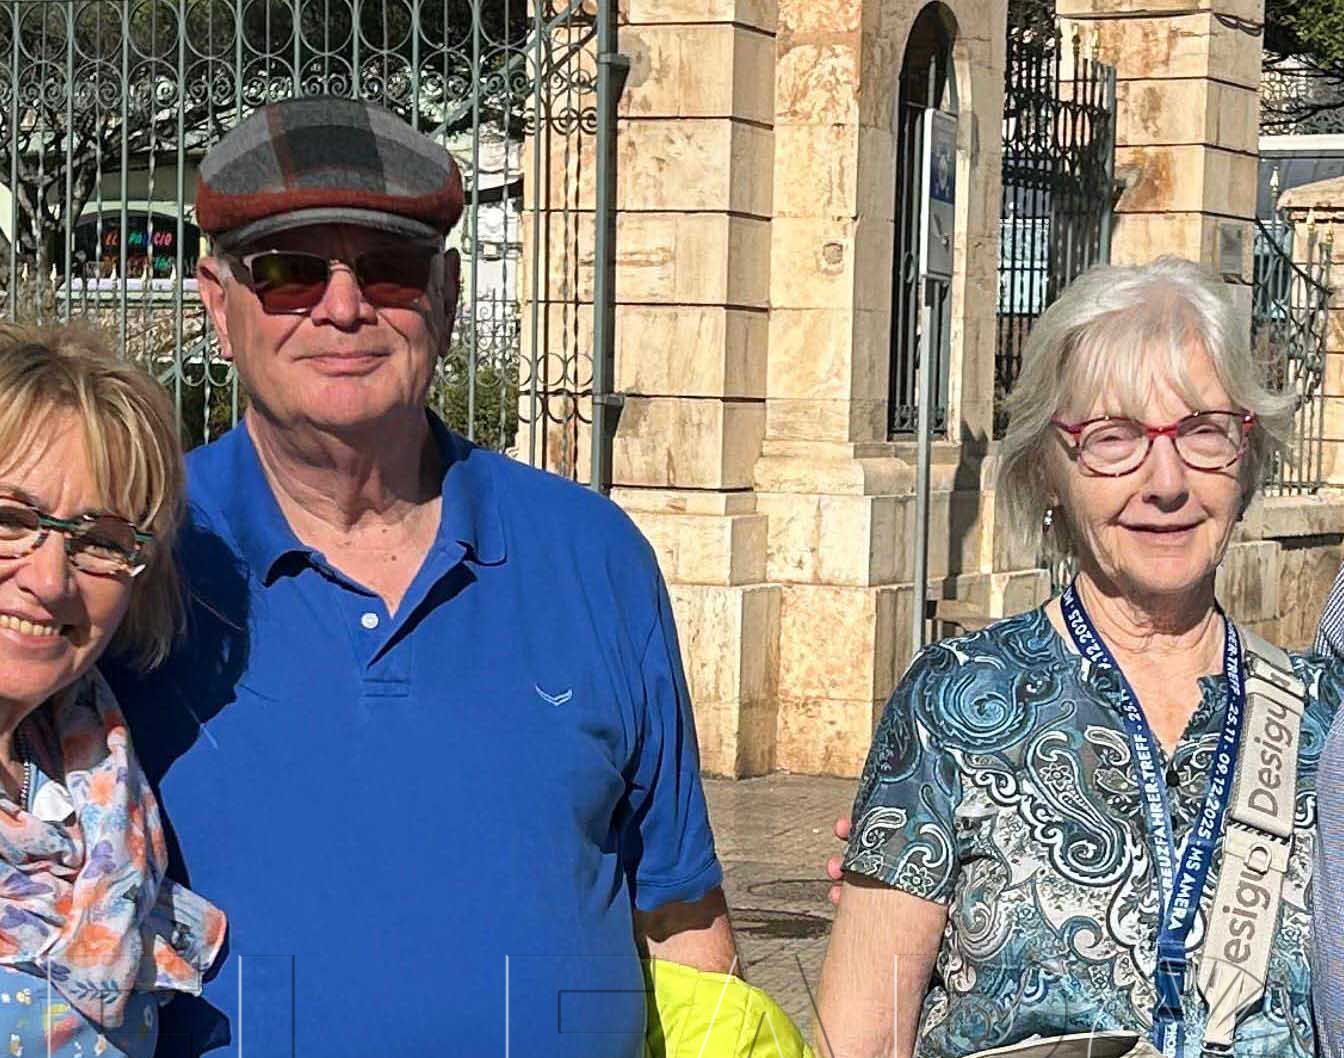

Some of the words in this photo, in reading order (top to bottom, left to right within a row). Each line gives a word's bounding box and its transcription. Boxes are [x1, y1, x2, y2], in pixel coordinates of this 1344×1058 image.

[1197, 752, 1231, 841] 09.12.2025
[1185, 846, 1205, 872] MS
[1167, 875, 1200, 930] AMERA
